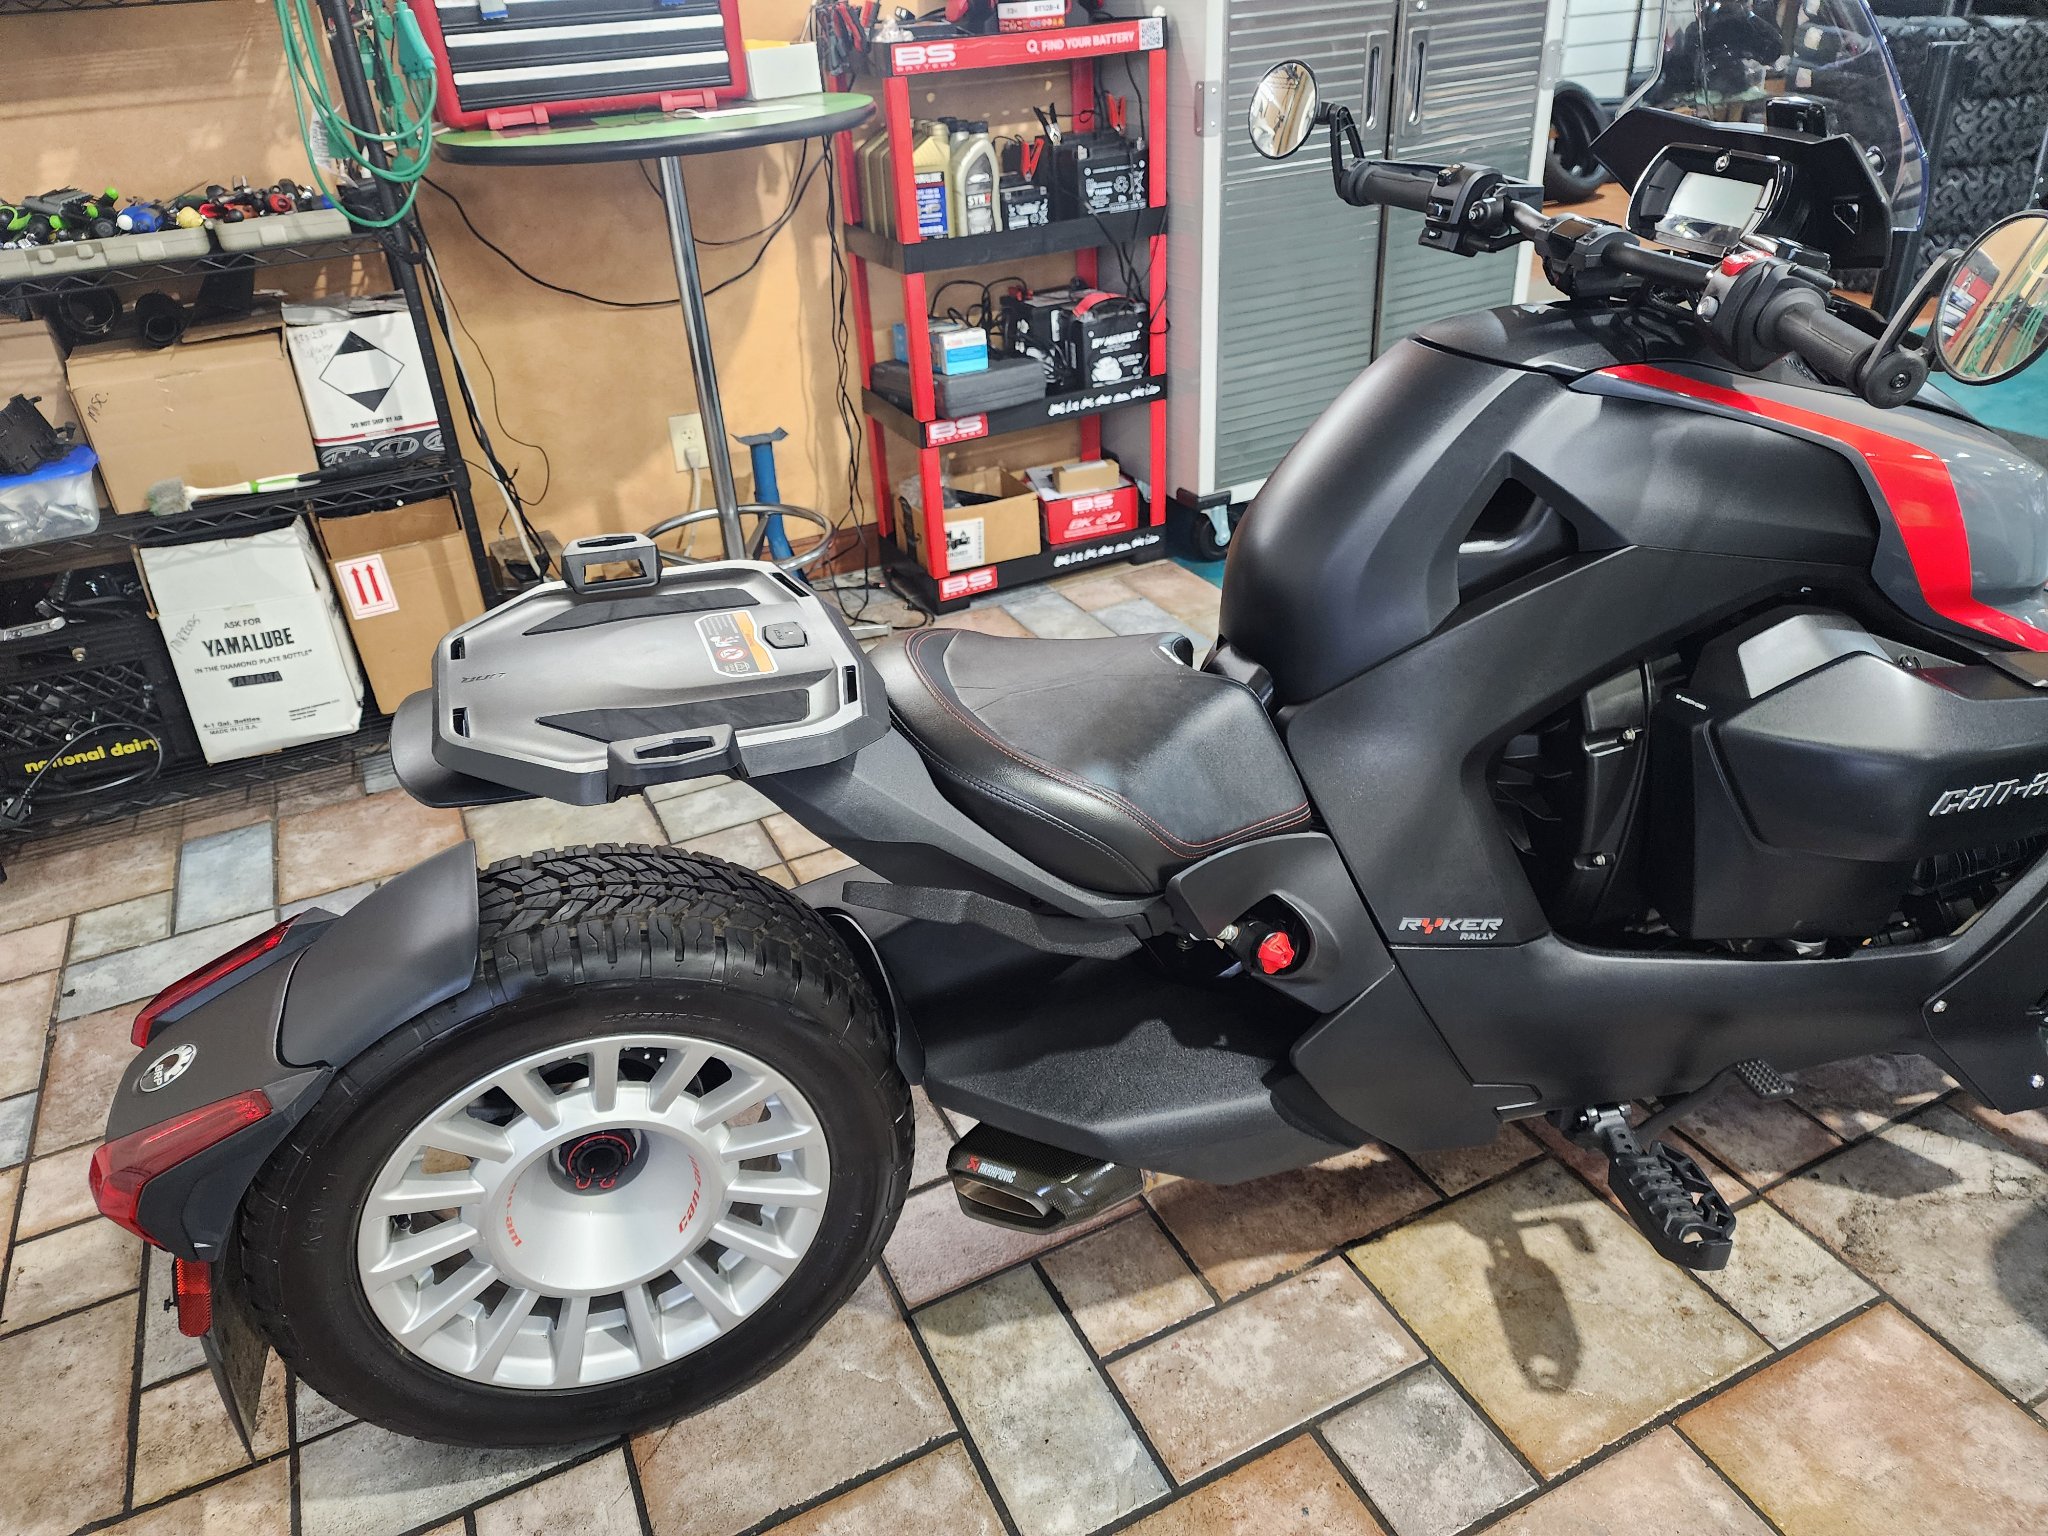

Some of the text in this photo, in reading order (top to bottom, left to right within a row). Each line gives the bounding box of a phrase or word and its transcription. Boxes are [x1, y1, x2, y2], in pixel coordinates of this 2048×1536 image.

[1041, 31, 1135, 51] FIND YOUR BATTERY
[895, 43, 957, 66] BS
[929, 415, 983, 439] BS
[1072, 493, 1114, 512] BS
[942, 569, 993, 594] BS
[224, 617, 262, 629] ASK FOR
[202, 627, 295, 657] YAMALUBE
[204, 664, 219, 672] THE
[220, 659, 257, 671] DIAMOND
[259, 655, 281, 665] PLATE
[228, 671, 283, 687] YAMAHA
[1398, 917, 1503, 935] RYKER
[1459, 932, 1497, 941] RALLY
[153, 1063, 164, 1086] BRP
